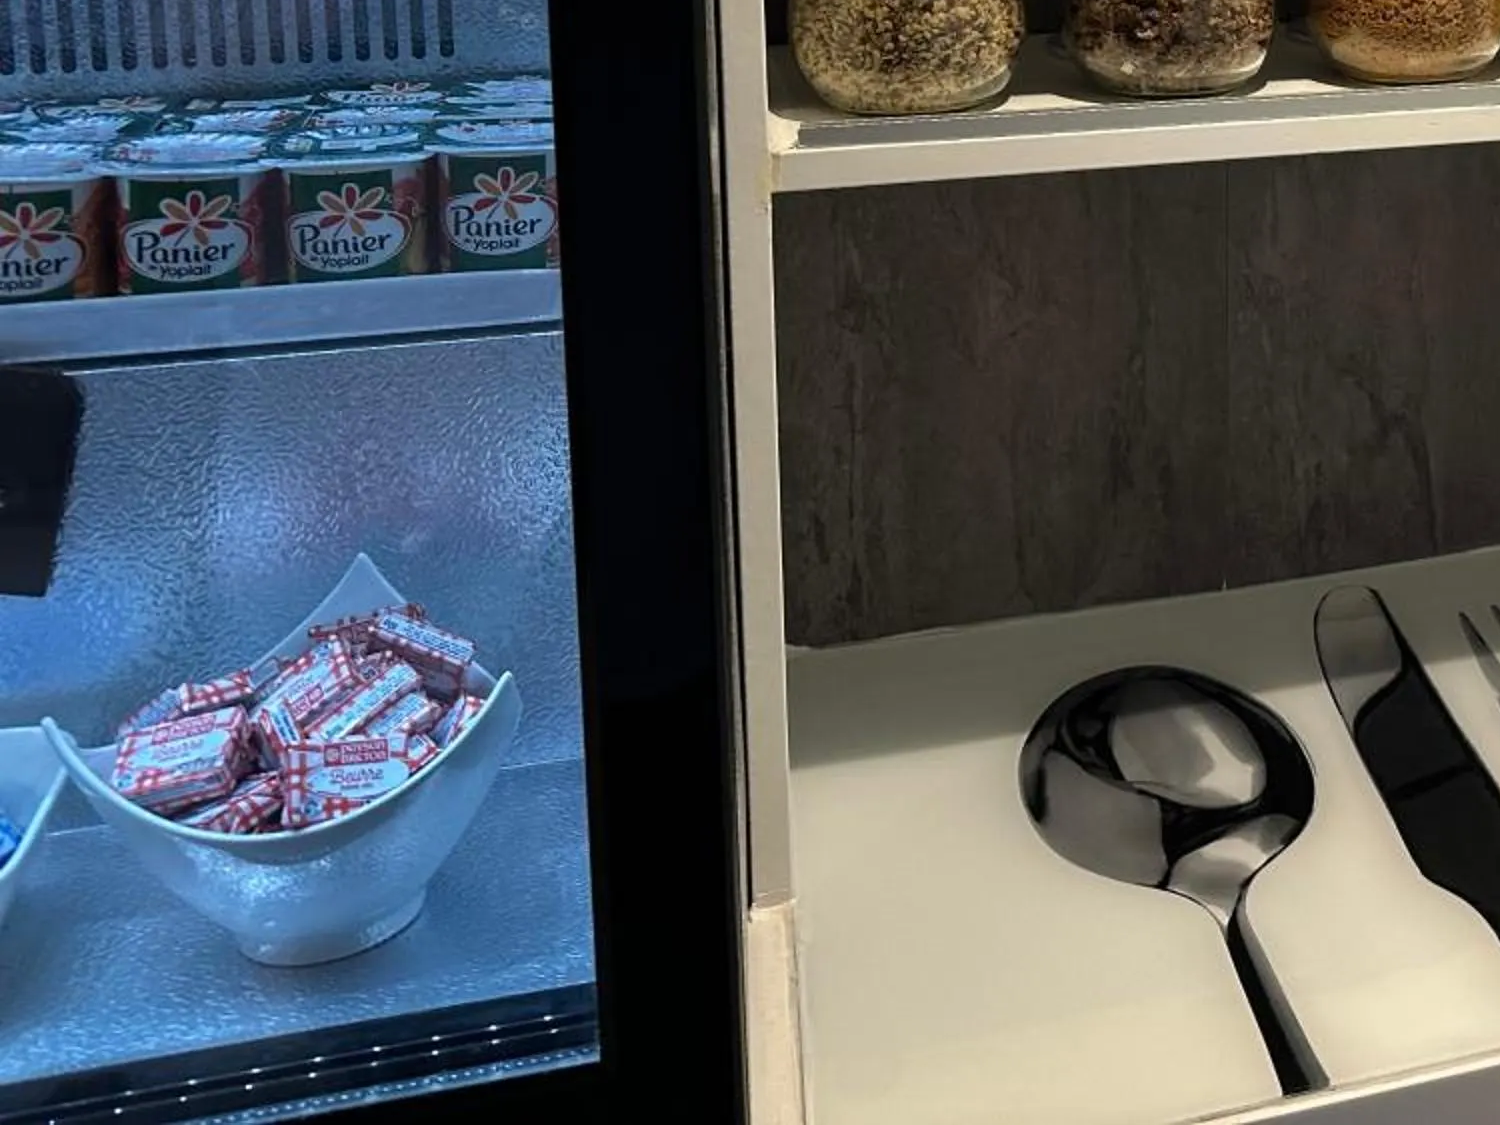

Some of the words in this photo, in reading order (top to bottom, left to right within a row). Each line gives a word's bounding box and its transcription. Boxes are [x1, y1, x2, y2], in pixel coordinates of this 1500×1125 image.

[451, 205, 542, 237] Panier
[130, 230, 235, 263] Panier
[294, 223, 392, 256] Panier
[2, 256, 71, 277] nier
